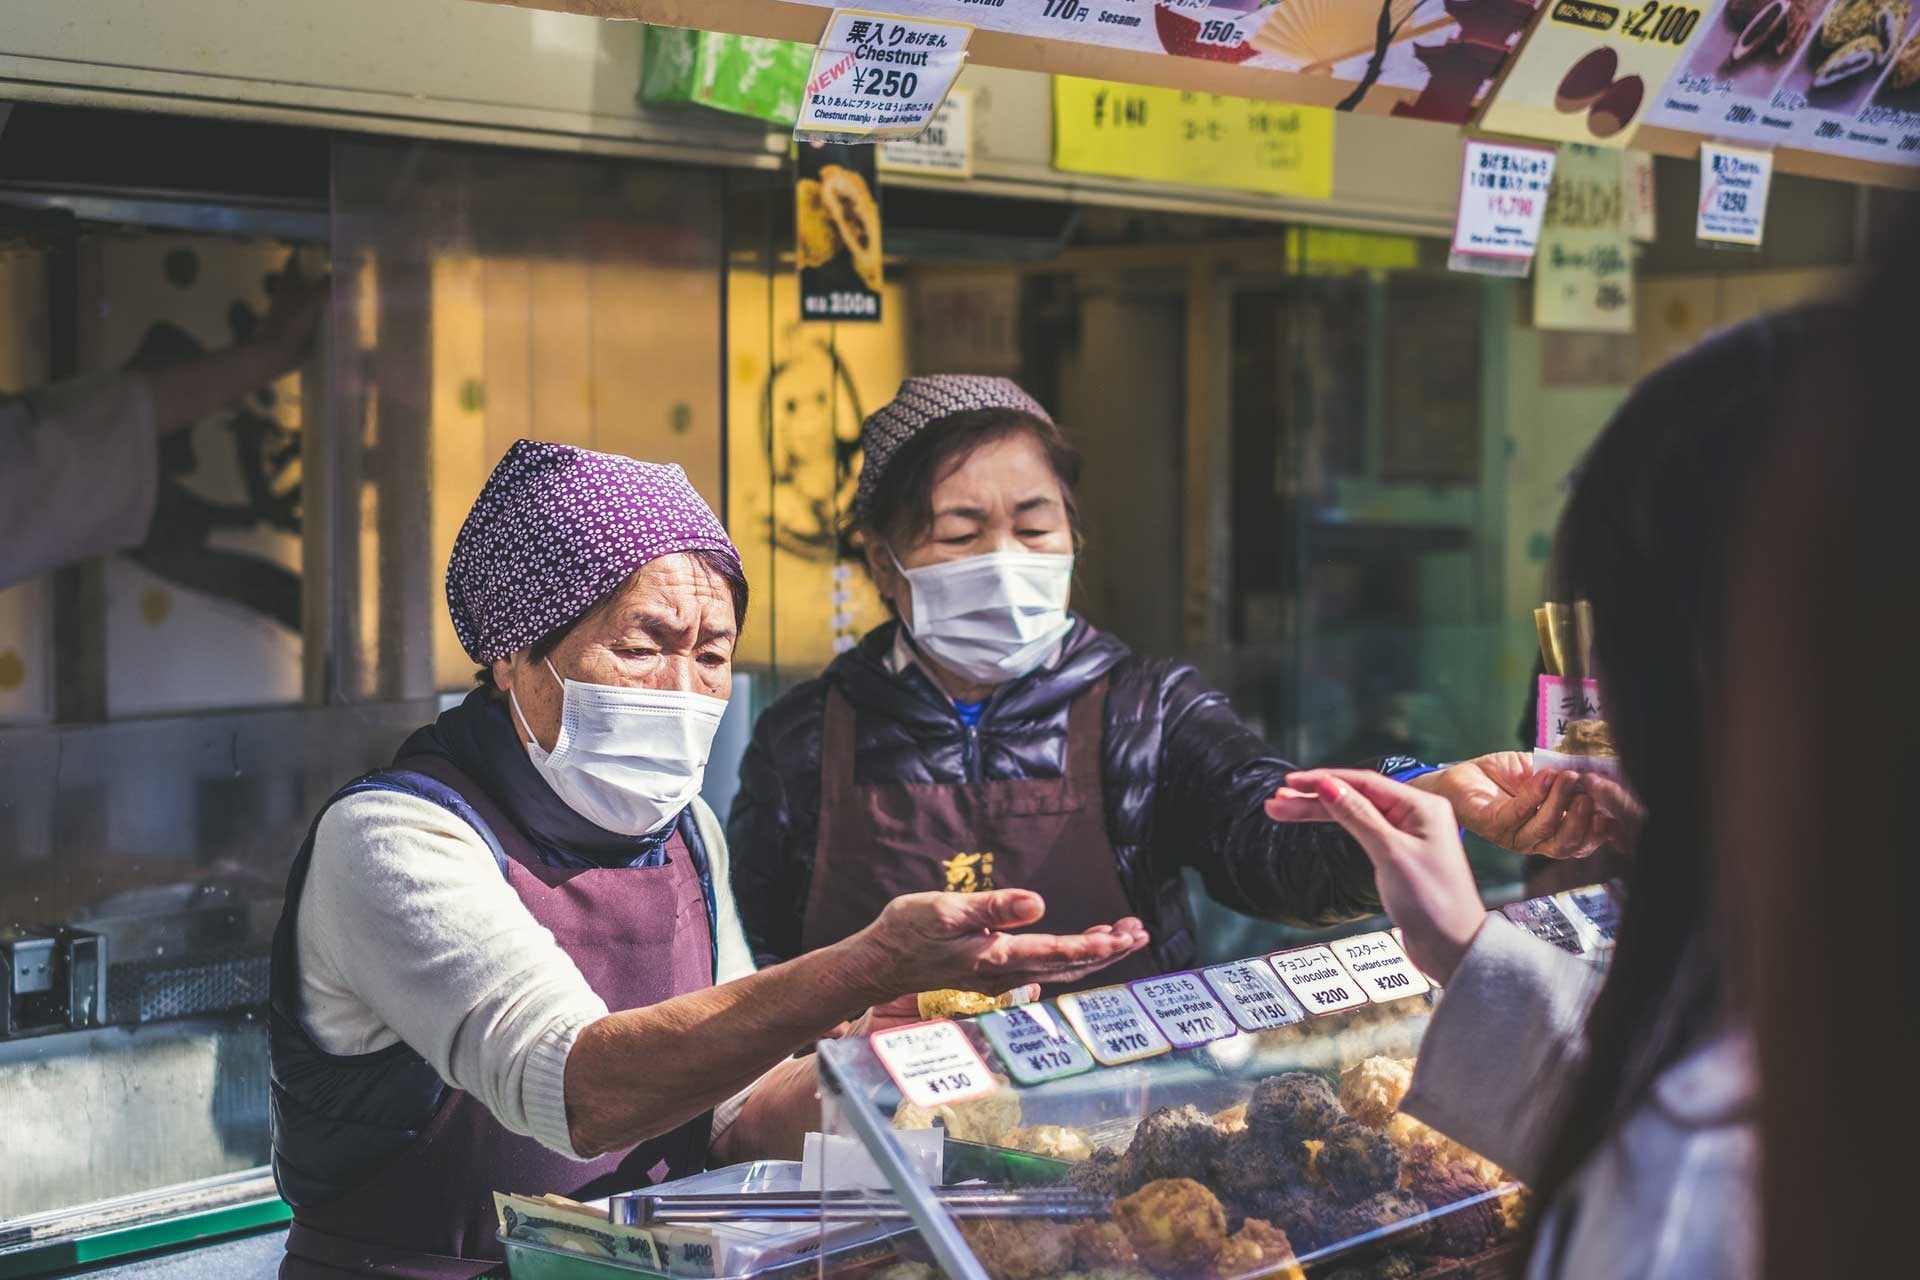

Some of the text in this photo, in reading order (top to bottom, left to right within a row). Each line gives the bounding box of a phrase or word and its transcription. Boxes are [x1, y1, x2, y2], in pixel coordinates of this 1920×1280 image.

[1043, 0, 1090, 22] 170円
[1098, 10, 1244, 44] Sesame 150円
[1621, 1, 1700, 45] ¥2,100
[846, 21, 948, 48] 栗入りあげまん
[855, 44, 929, 66] Chestnut
[806, 53, 856, 97] NEW!!
[852, 66, 918, 99] ¥250
[814, 109, 848, 121] Chestnut
[848, 113, 872, 124] manju
[1346, 941, 1388, 959] カスタード
[1278, 952, 1330, 972] チョコレート
[1353, 956, 1404, 972] Custard cream
[1224, 967, 1256, 984] ごま
[1292, 968, 1339, 985] chocolate
[1374, 973, 1410, 991] ¥200
[1144, 979, 1194, 998] さつまいも
[1312, 987, 1349, 1006] ¥200
[1156, 1007, 1184, 1019] Sweet
[1091, 1018, 1138, 1035] Pumpkn
[1176, 1016, 1215, 1036] ¥170
[1009, 1040, 1046, 1054] Green
[1107, 1033, 1149, 1052] ¥170
[1027, 1050, 1072, 1071] ¥170
[928, 1072, 971, 1092] ¥130
